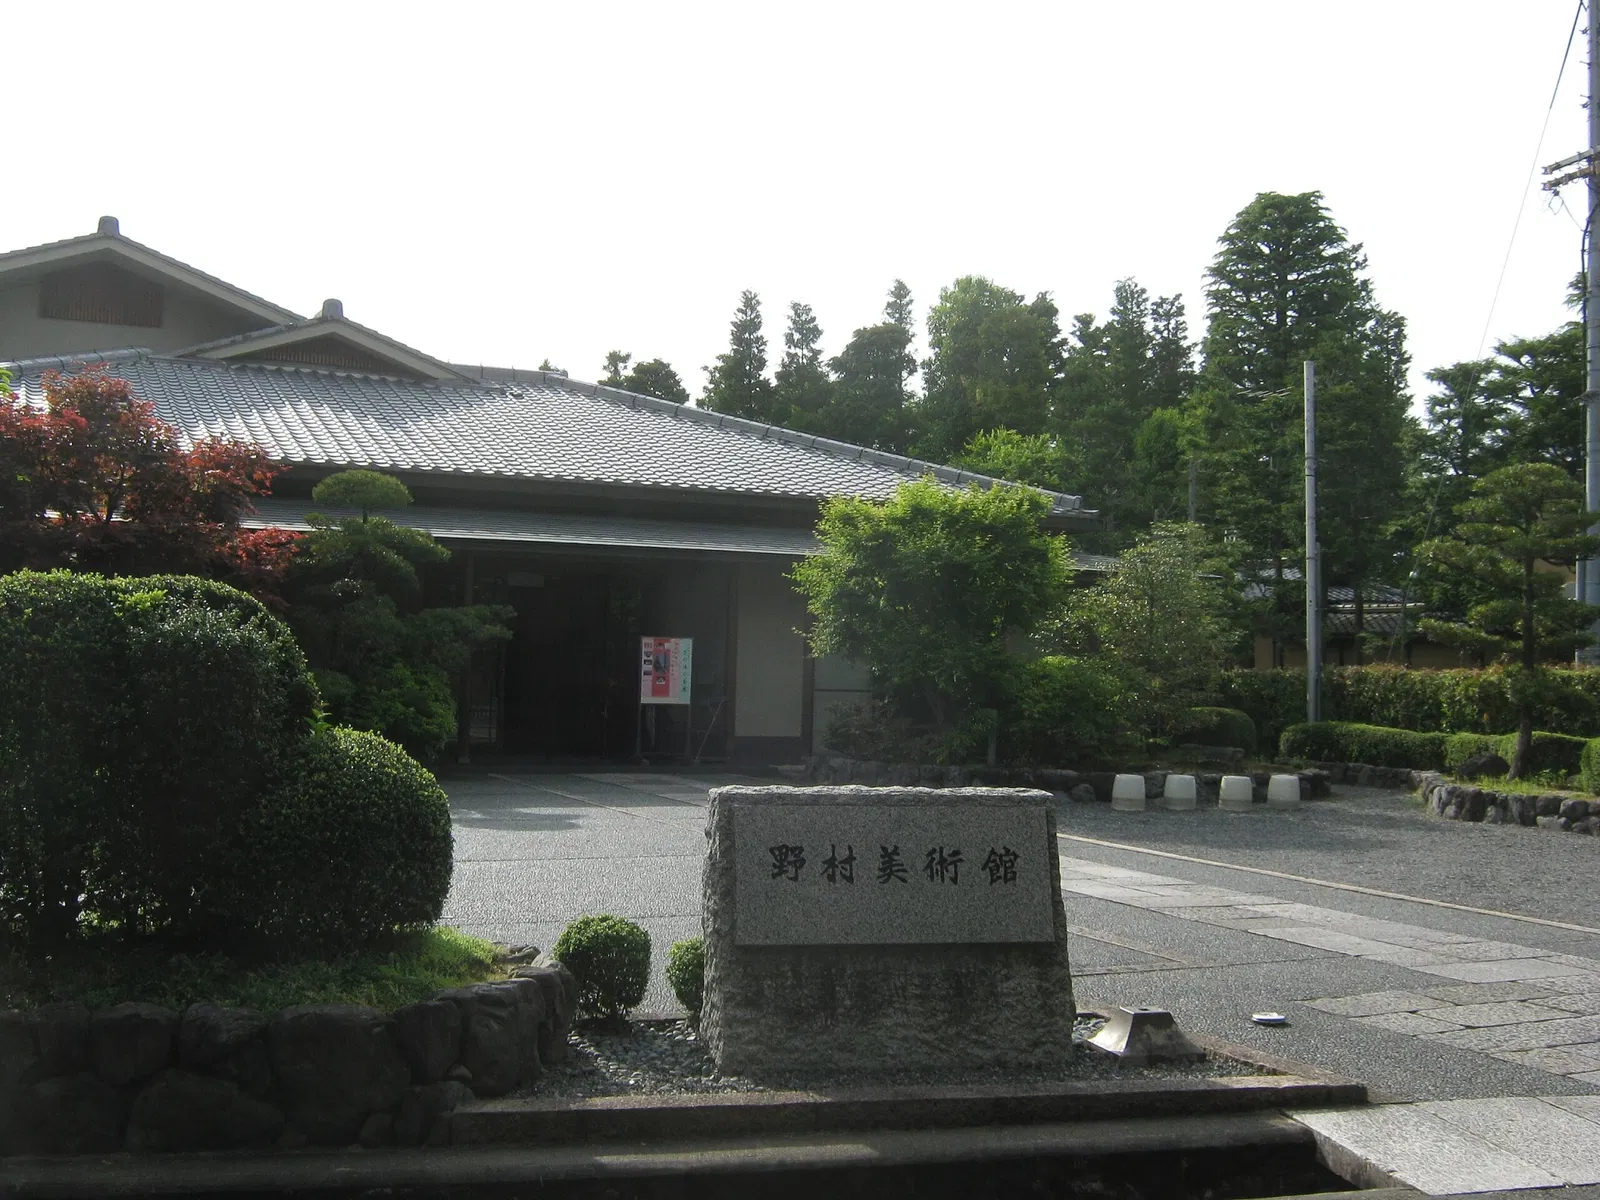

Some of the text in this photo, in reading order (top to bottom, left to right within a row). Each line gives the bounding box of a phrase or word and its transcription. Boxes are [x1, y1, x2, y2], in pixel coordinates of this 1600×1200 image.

[769, 843, 1020, 885] 野村美術館
